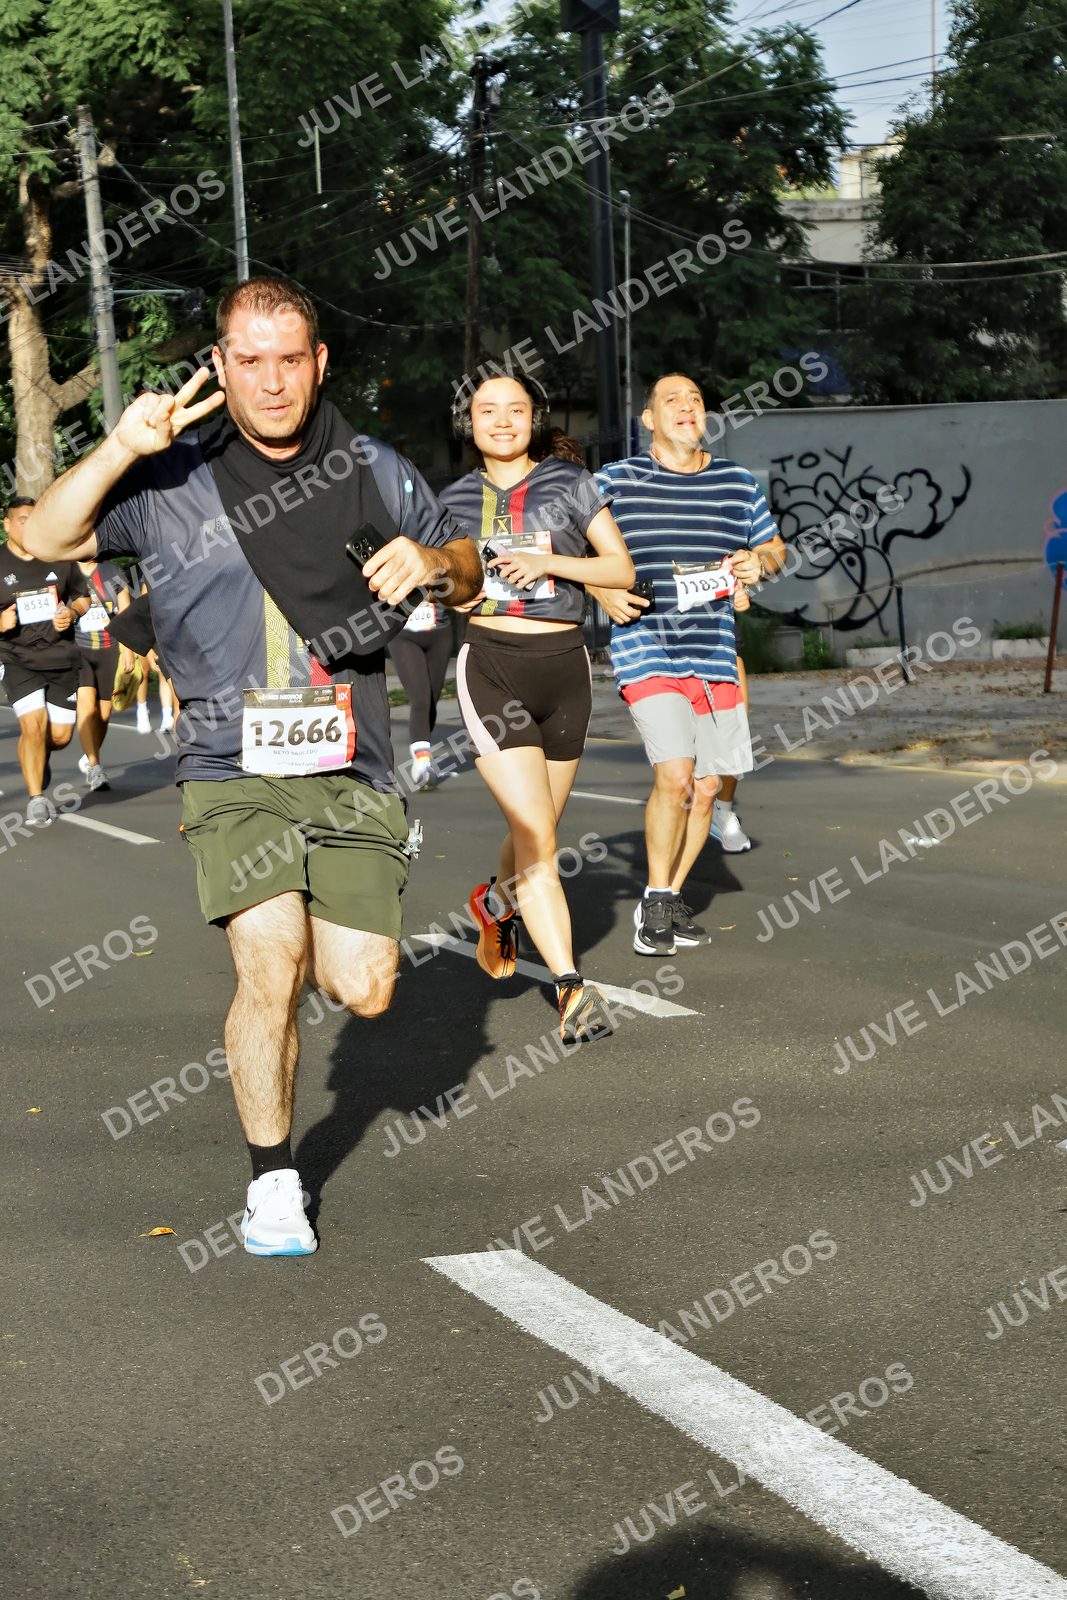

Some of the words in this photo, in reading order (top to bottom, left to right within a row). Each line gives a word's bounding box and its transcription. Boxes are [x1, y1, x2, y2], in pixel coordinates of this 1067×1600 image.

[770, 445, 853, 477] TOY
[23, 597, 50, 611] 8534
[250, 716, 342, 747] 12666
